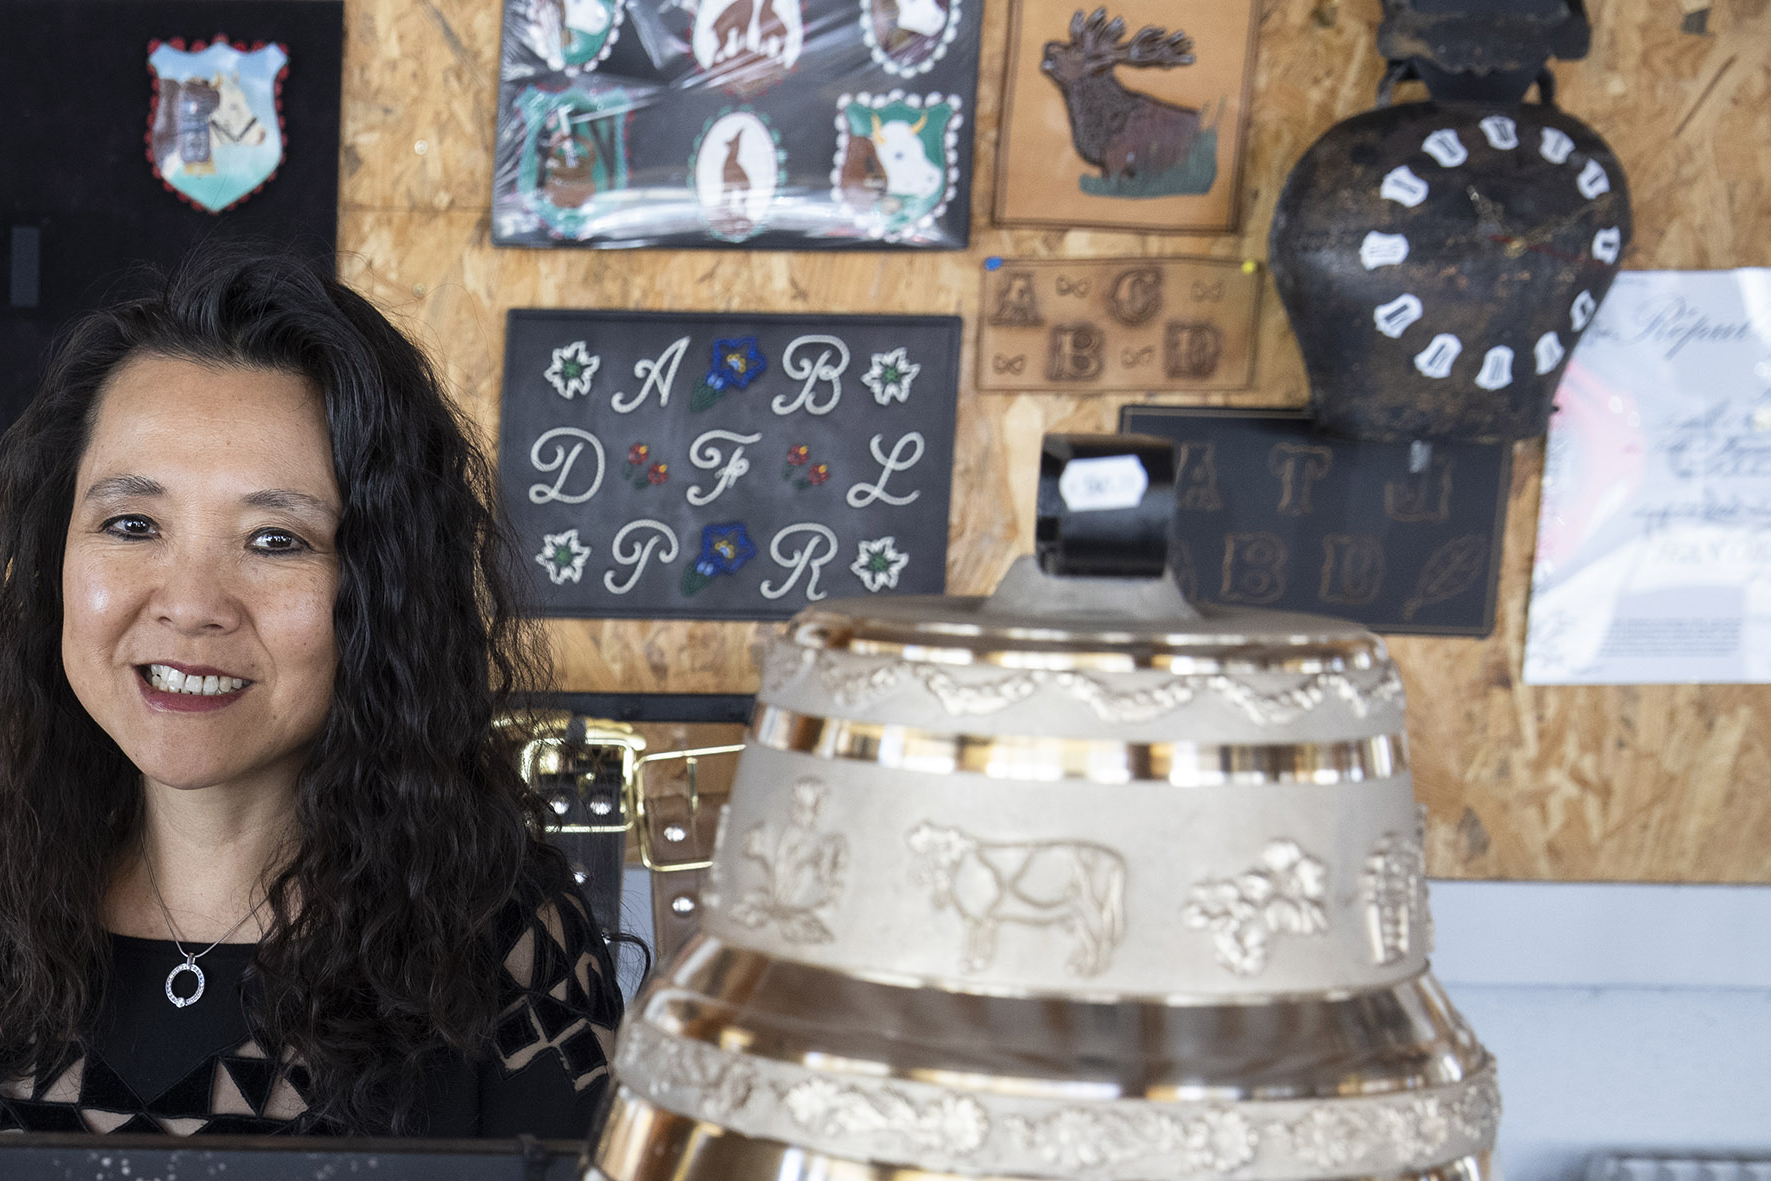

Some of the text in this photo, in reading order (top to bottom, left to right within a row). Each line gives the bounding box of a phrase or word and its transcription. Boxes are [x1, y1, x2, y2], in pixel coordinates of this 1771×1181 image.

[990, 266, 1163, 327] A C
[610, 333, 851, 416] A B
[1046, 321, 1224, 382] B D
[528, 426, 925, 508] D F L
[603, 519, 839, 601] P R
